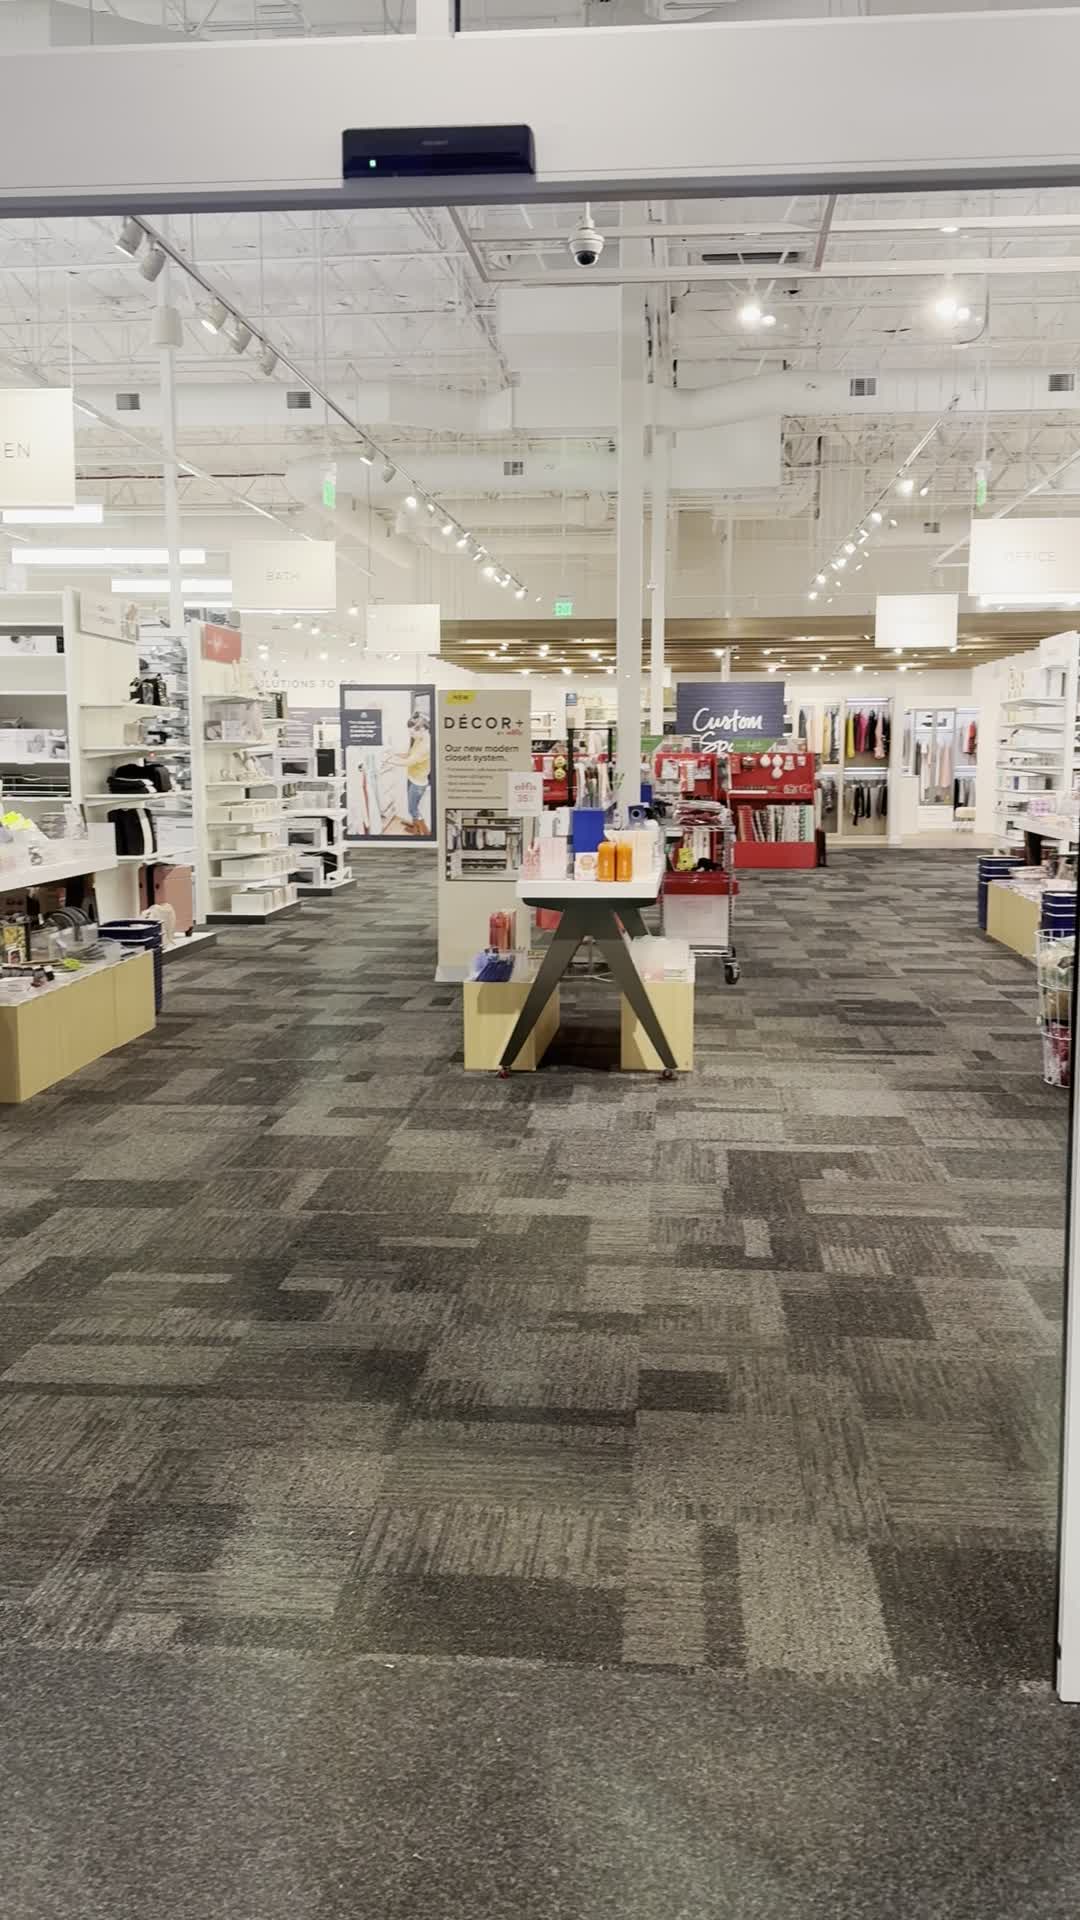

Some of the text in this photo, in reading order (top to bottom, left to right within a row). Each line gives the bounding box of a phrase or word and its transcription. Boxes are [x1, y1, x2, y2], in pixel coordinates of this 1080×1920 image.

[265, 570, 300, 582] BATH
[256, 679, 316, 689] OLUTIONS
[692, 707, 763, 732] Custom
[444, 744, 462, 752] Our
[484, 744, 519, 752] modern
[444, 754, 472, 762] closet
